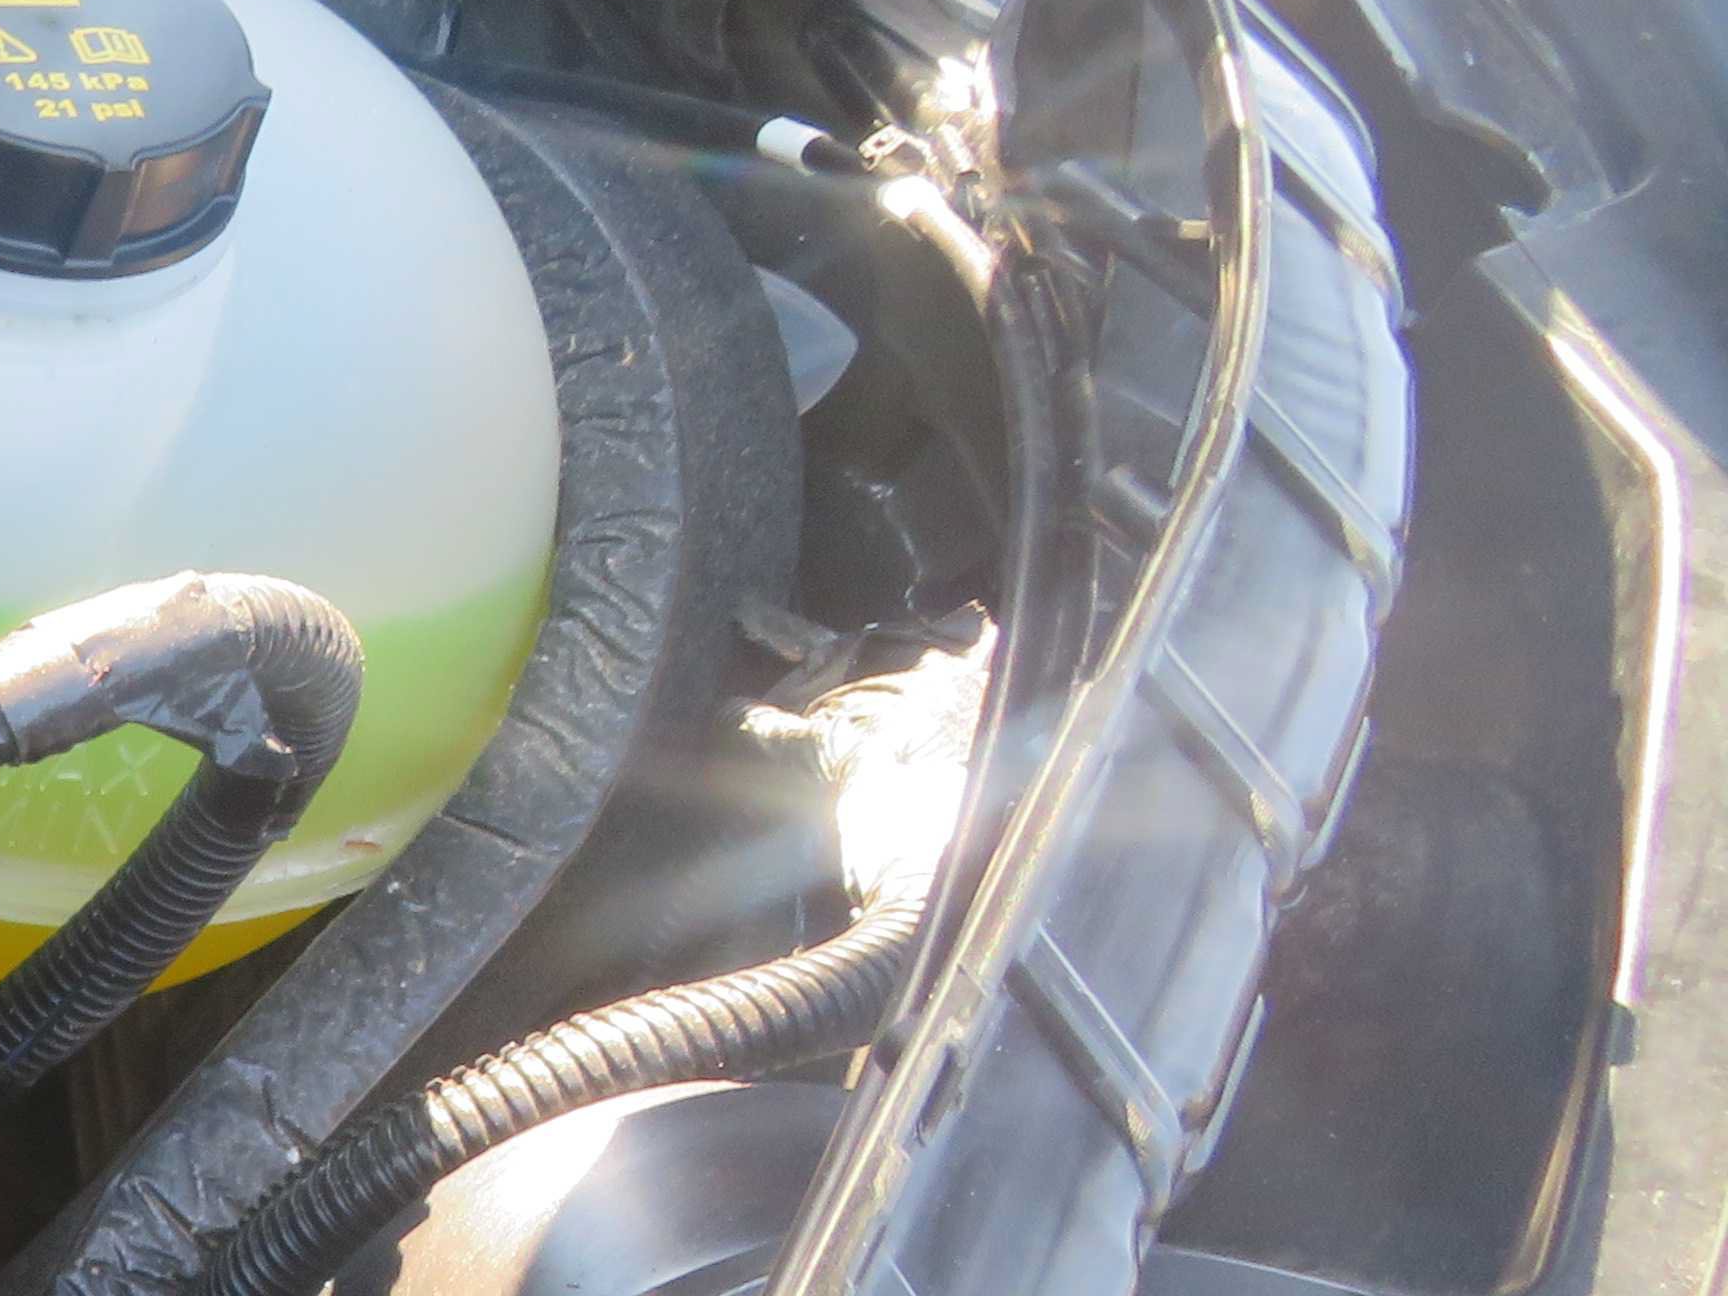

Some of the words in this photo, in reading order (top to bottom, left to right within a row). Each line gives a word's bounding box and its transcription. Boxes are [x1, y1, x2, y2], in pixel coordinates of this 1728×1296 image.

[5, 72, 71, 91] 145
[79, 72, 149, 91] kPa
[34, 98, 79, 118] 21
[90, 98, 145, 123] psi
